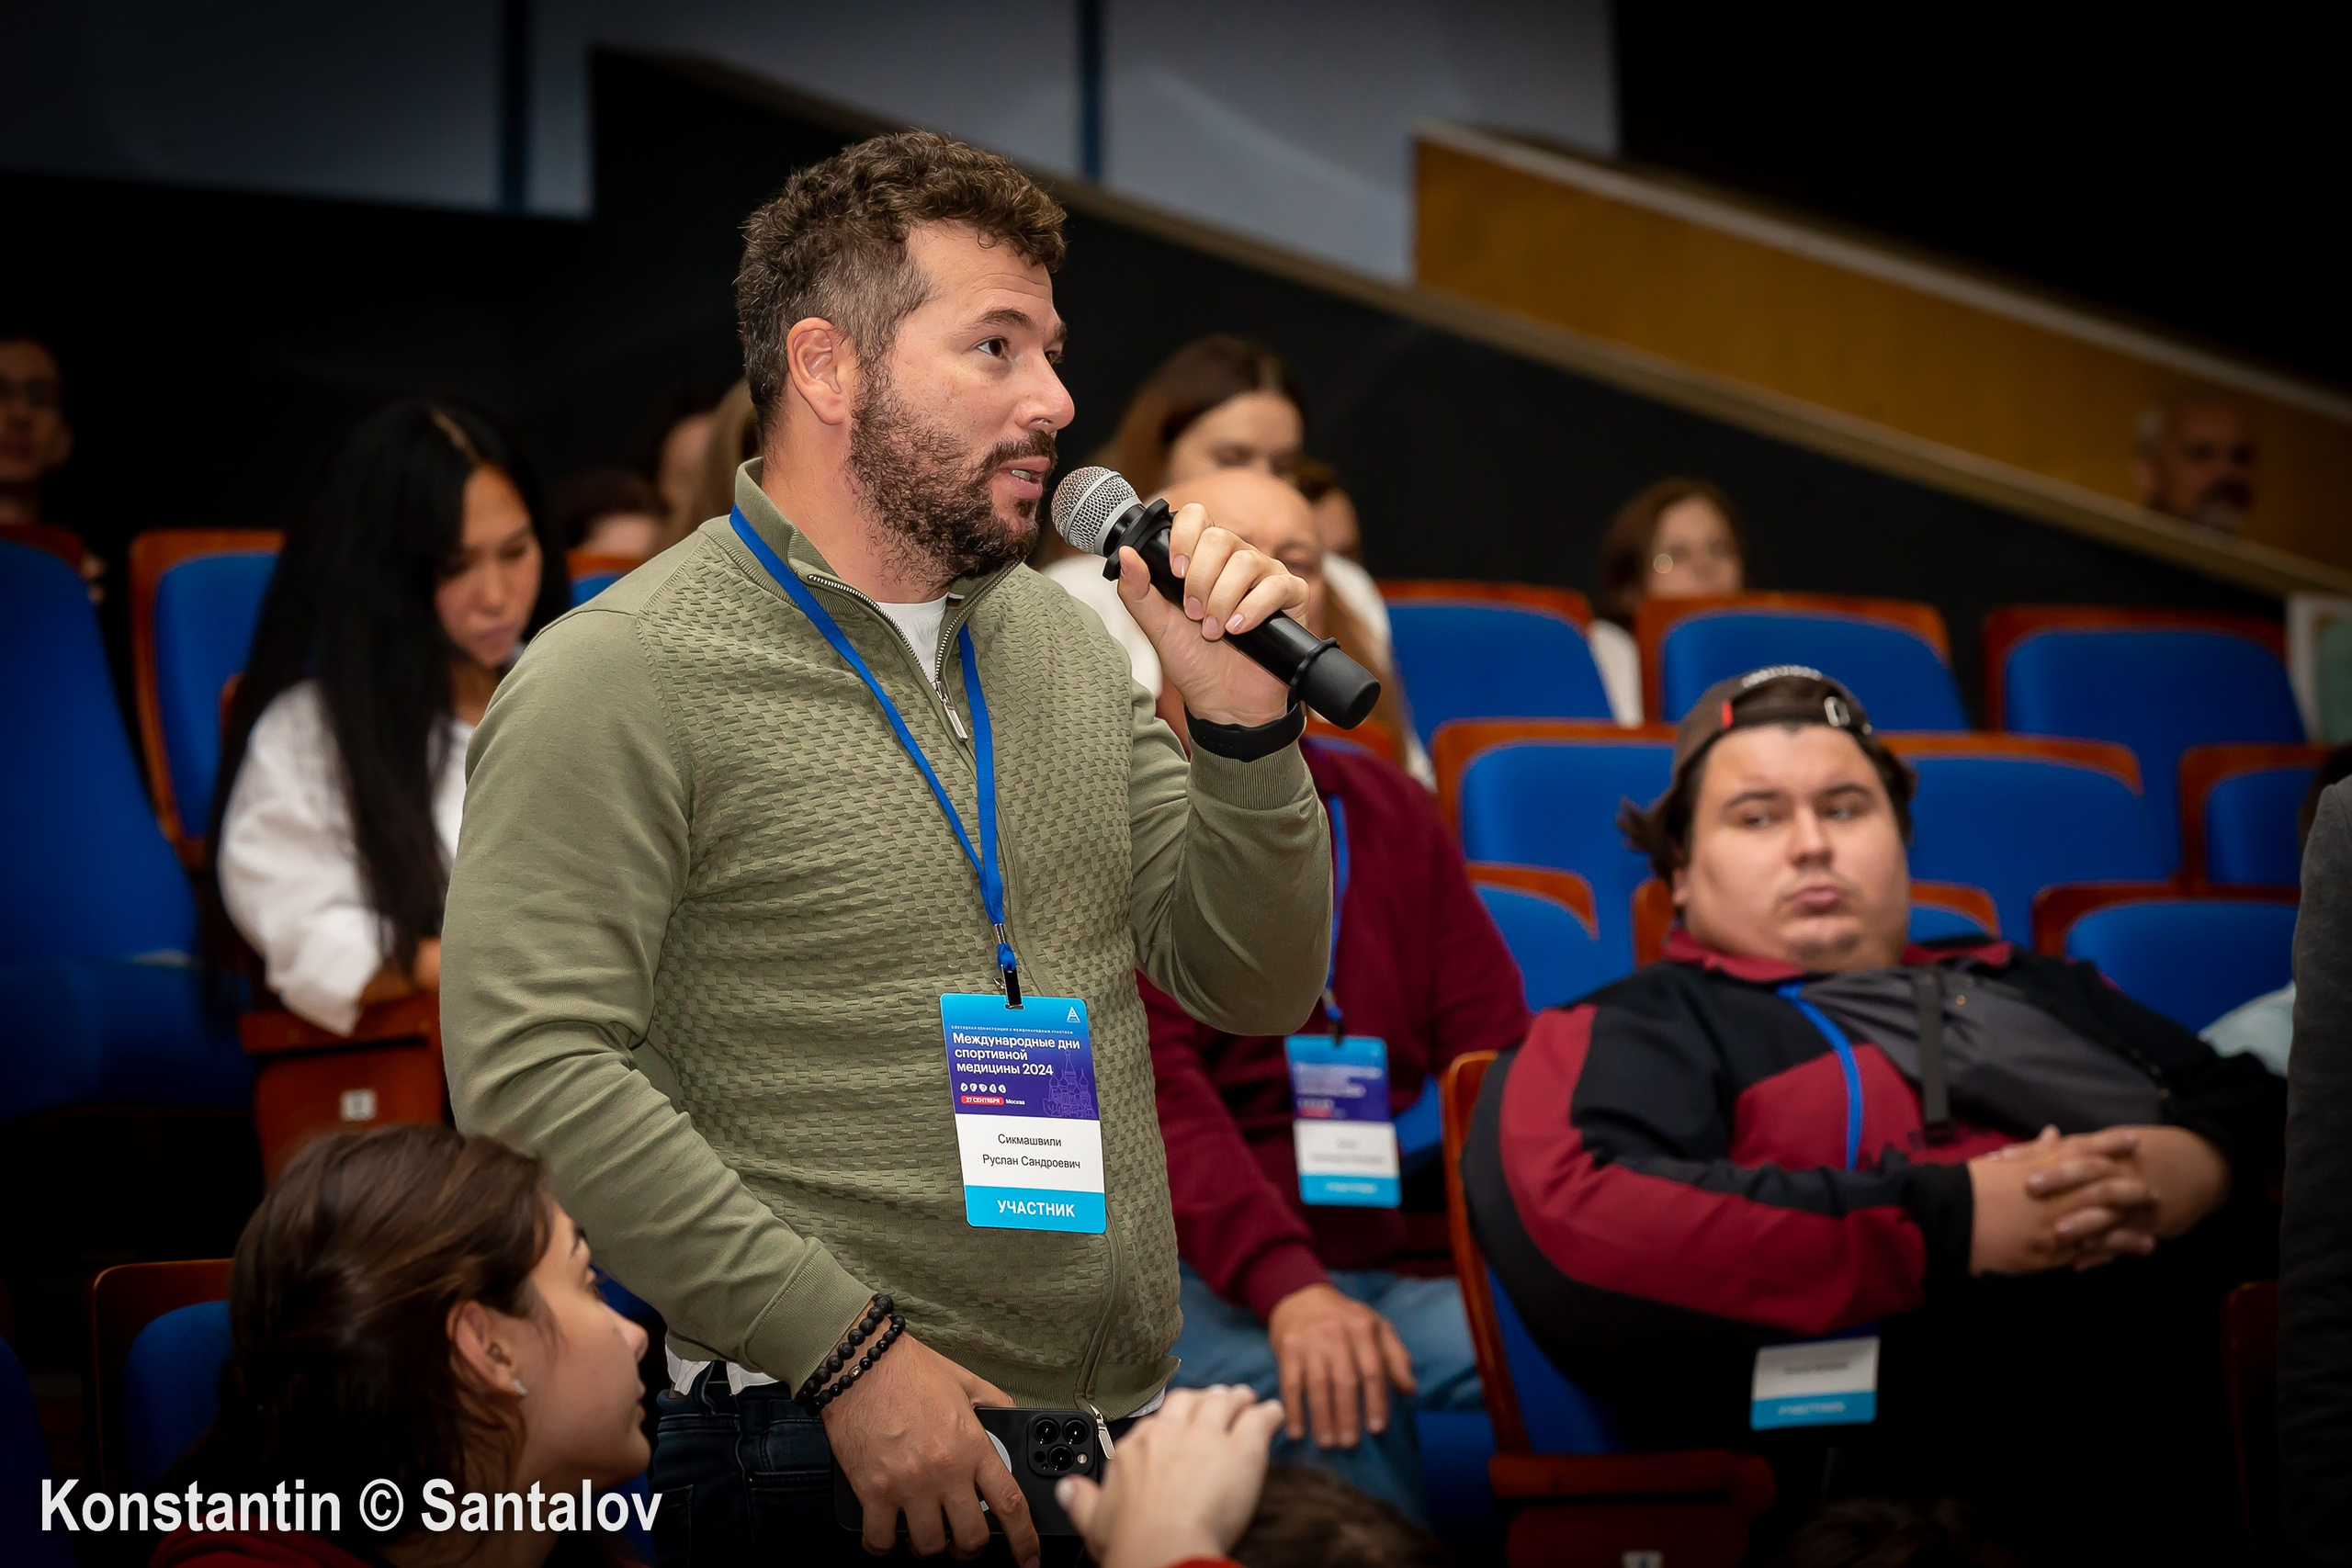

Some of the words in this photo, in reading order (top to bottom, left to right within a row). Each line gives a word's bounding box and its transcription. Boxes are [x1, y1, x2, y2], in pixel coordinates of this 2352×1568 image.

[953, 1032, 1056, 1048] Международные
[1057, 1039, 1080, 1050] дни
[955, 1048, 1028, 1061] спортивной
[956, 1063, 1021, 1075] медицины
[1022, 1063, 1054, 1076] 2024
[998, 1134, 1062, 1146] Сикмашвили
[982, 1154, 1019, 1167] Руслан
[1021, 1156, 1080, 1169] Сандроевич
[997, 1200, 1075, 1217] УЧАСТНИК
